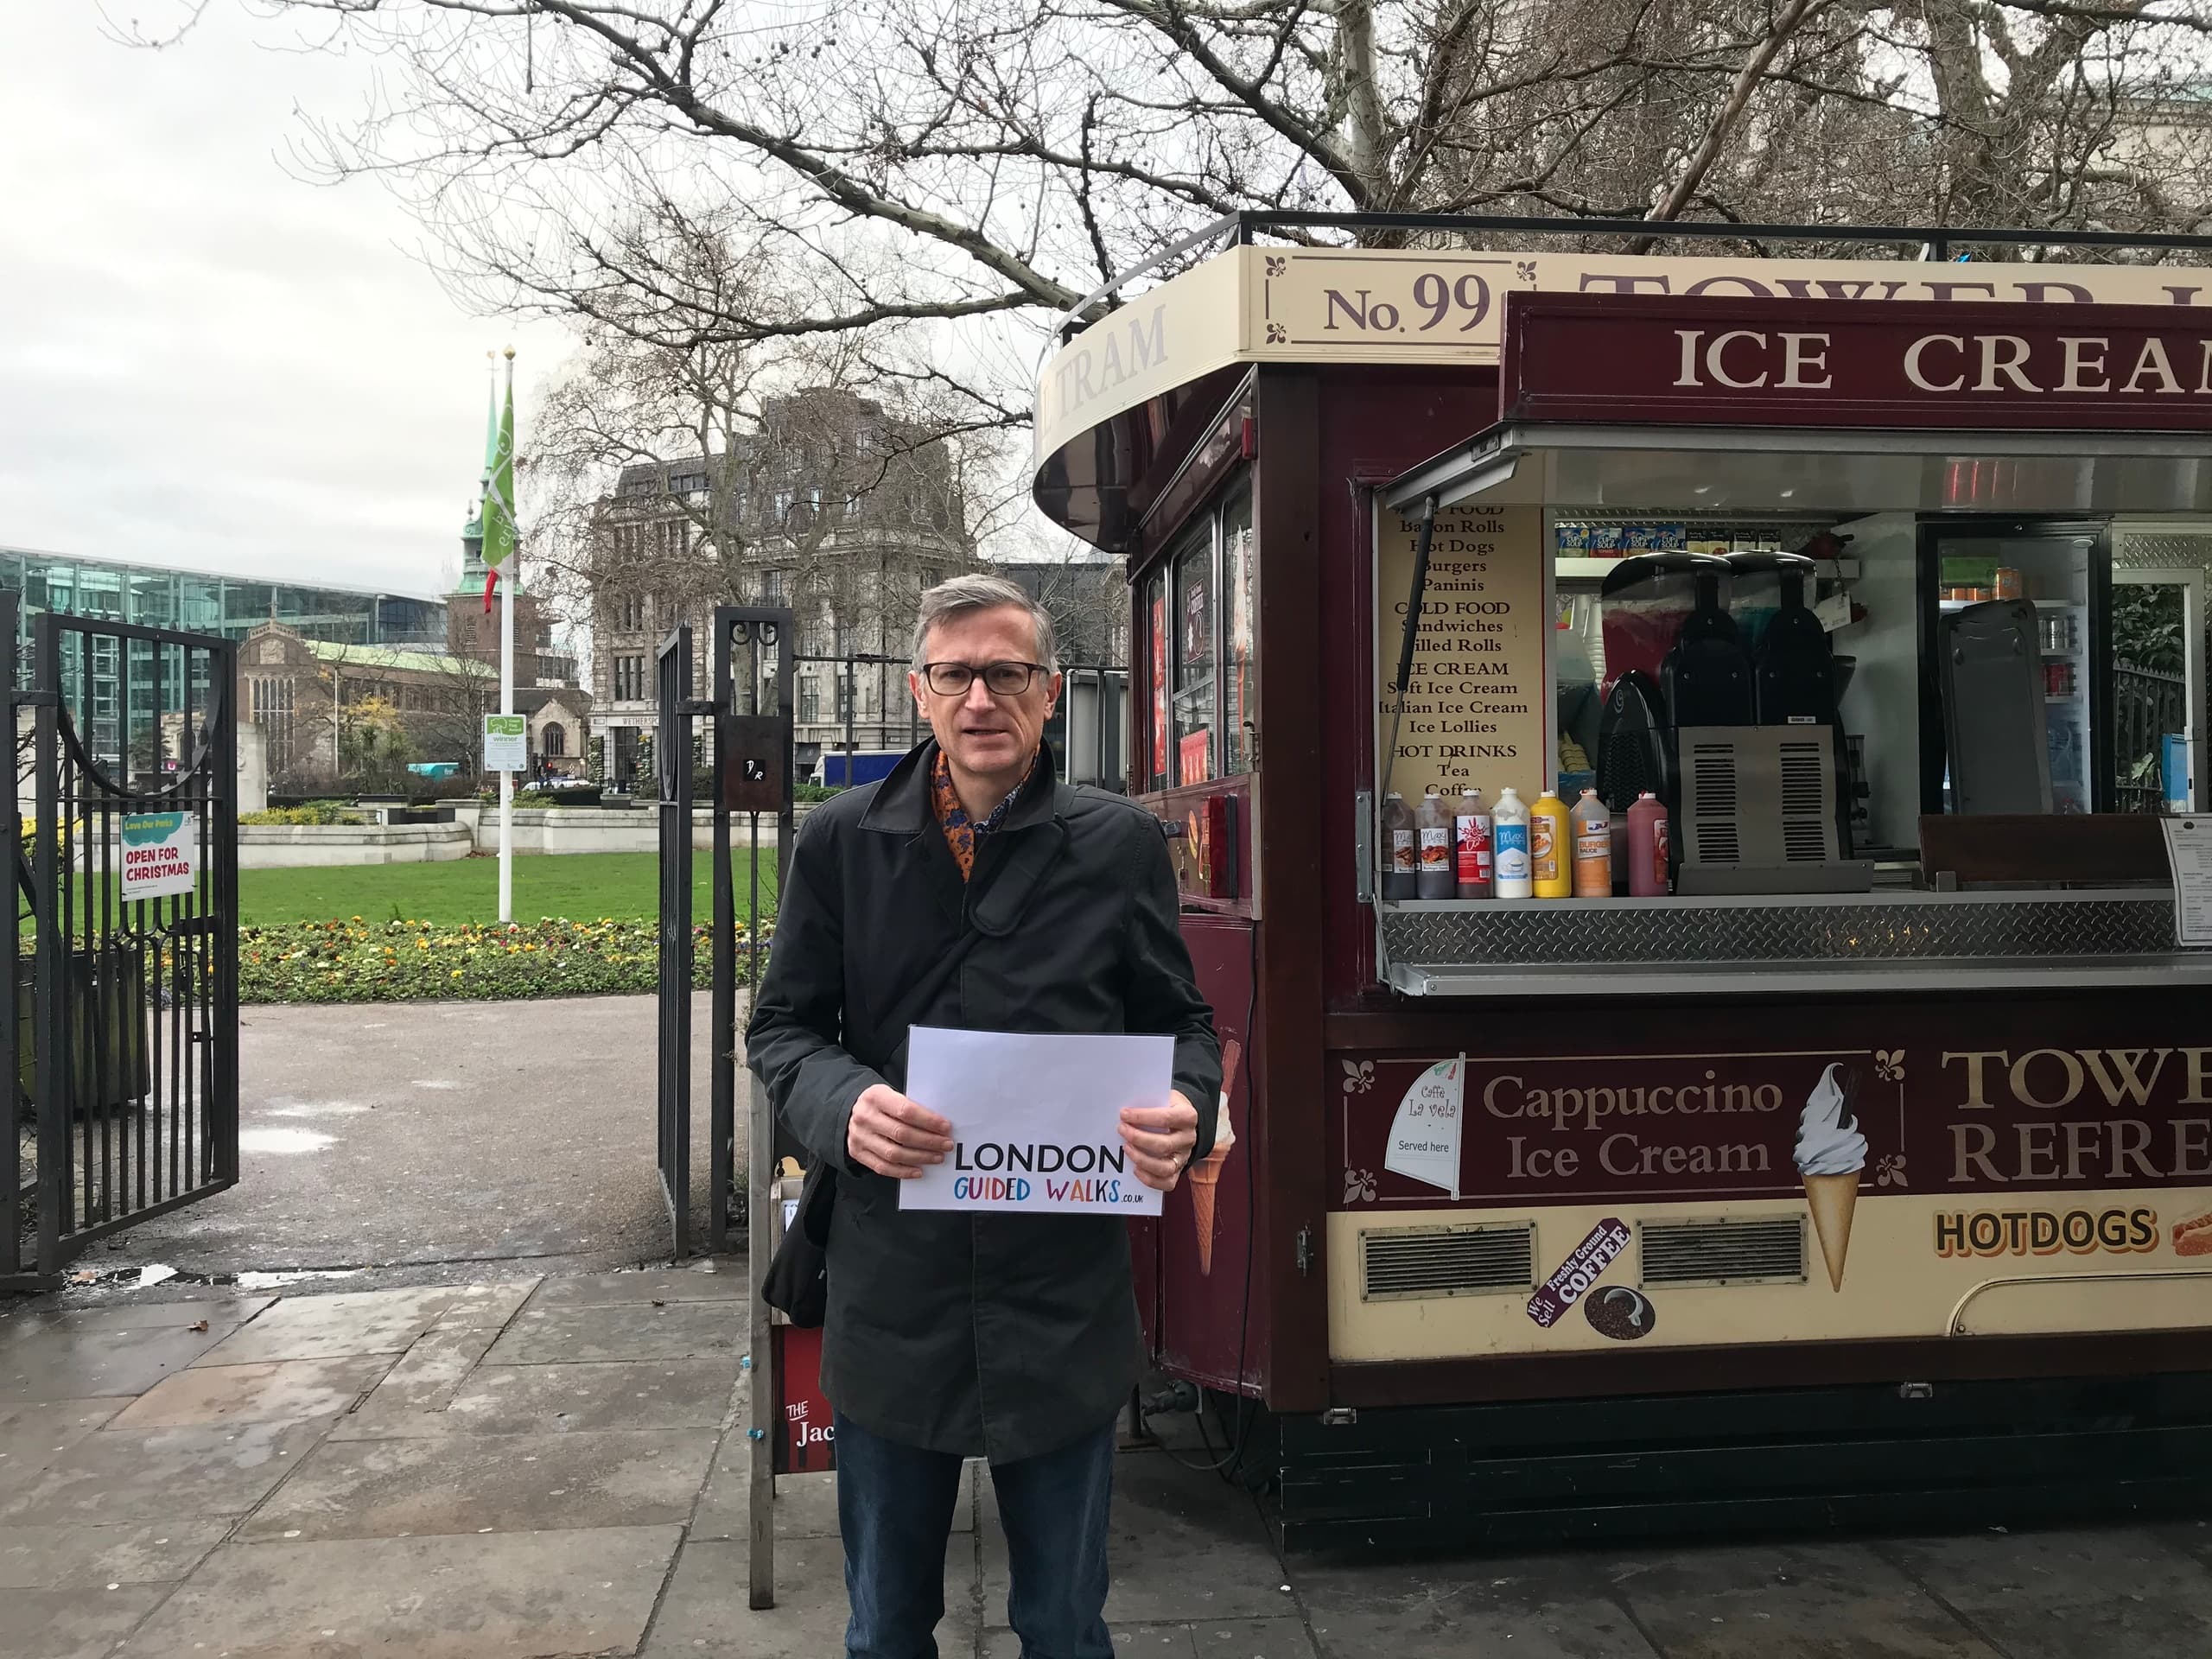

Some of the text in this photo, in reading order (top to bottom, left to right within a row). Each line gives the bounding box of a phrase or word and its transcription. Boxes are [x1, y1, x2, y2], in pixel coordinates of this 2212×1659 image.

[1323, 272, 1491, 334] No. 99
[1056, 304, 1169, 420] TRAM
[1673, 329, 1834, 390] ICE
[1400, 519, 1505, 533] Baon Rolls
[1449, 539, 1495, 556] Dogs
[1423, 578, 1484, 592] Paninis
[1455, 601, 1510, 614] FOOD
[1414, 639, 1502, 652] illed Rolls
[1433, 662, 1509, 676] CREAM
[1427, 681, 1453, 694] Ice
[1459, 681, 1518, 694] Cream
[1379, 701, 1529, 714] Italian Ice Cream
[1409, 721, 1497, 733] Ice Lollies
[1439, 745, 1517, 758] DRINKS
[1437, 764, 1470, 777] Tea
[126, 847, 178, 864] OPEN FOR
[126, 862, 189, 881] CHRISTMAS
[1941, 1046, 2212, 1109] TOWE
[1408, 1099, 1424, 1116] La
[1483, 1069, 1783, 1131] Cappuccino
[1398, 1141, 1449, 1153] Served here
[1506, 1133, 1771, 1179] Ice Cream
[1947, 1119, 2212, 1183] REFRE
[955, 1142, 1126, 1173] LONDON
[954, 1176, 1031, 1201] GUIDED
[1935, 1207, 2158, 1255] HOTDOGS
[1546, 1225, 1608, 1292] Freshly Ground
[1559, 1226, 1630, 1304] COFFEE
[1527, 1296, 1543, 1317] We
[1538, 1300, 1555, 1327] Sell
[785, 1400, 809, 1418] THE
[796, 1421, 836, 1447] Jac
